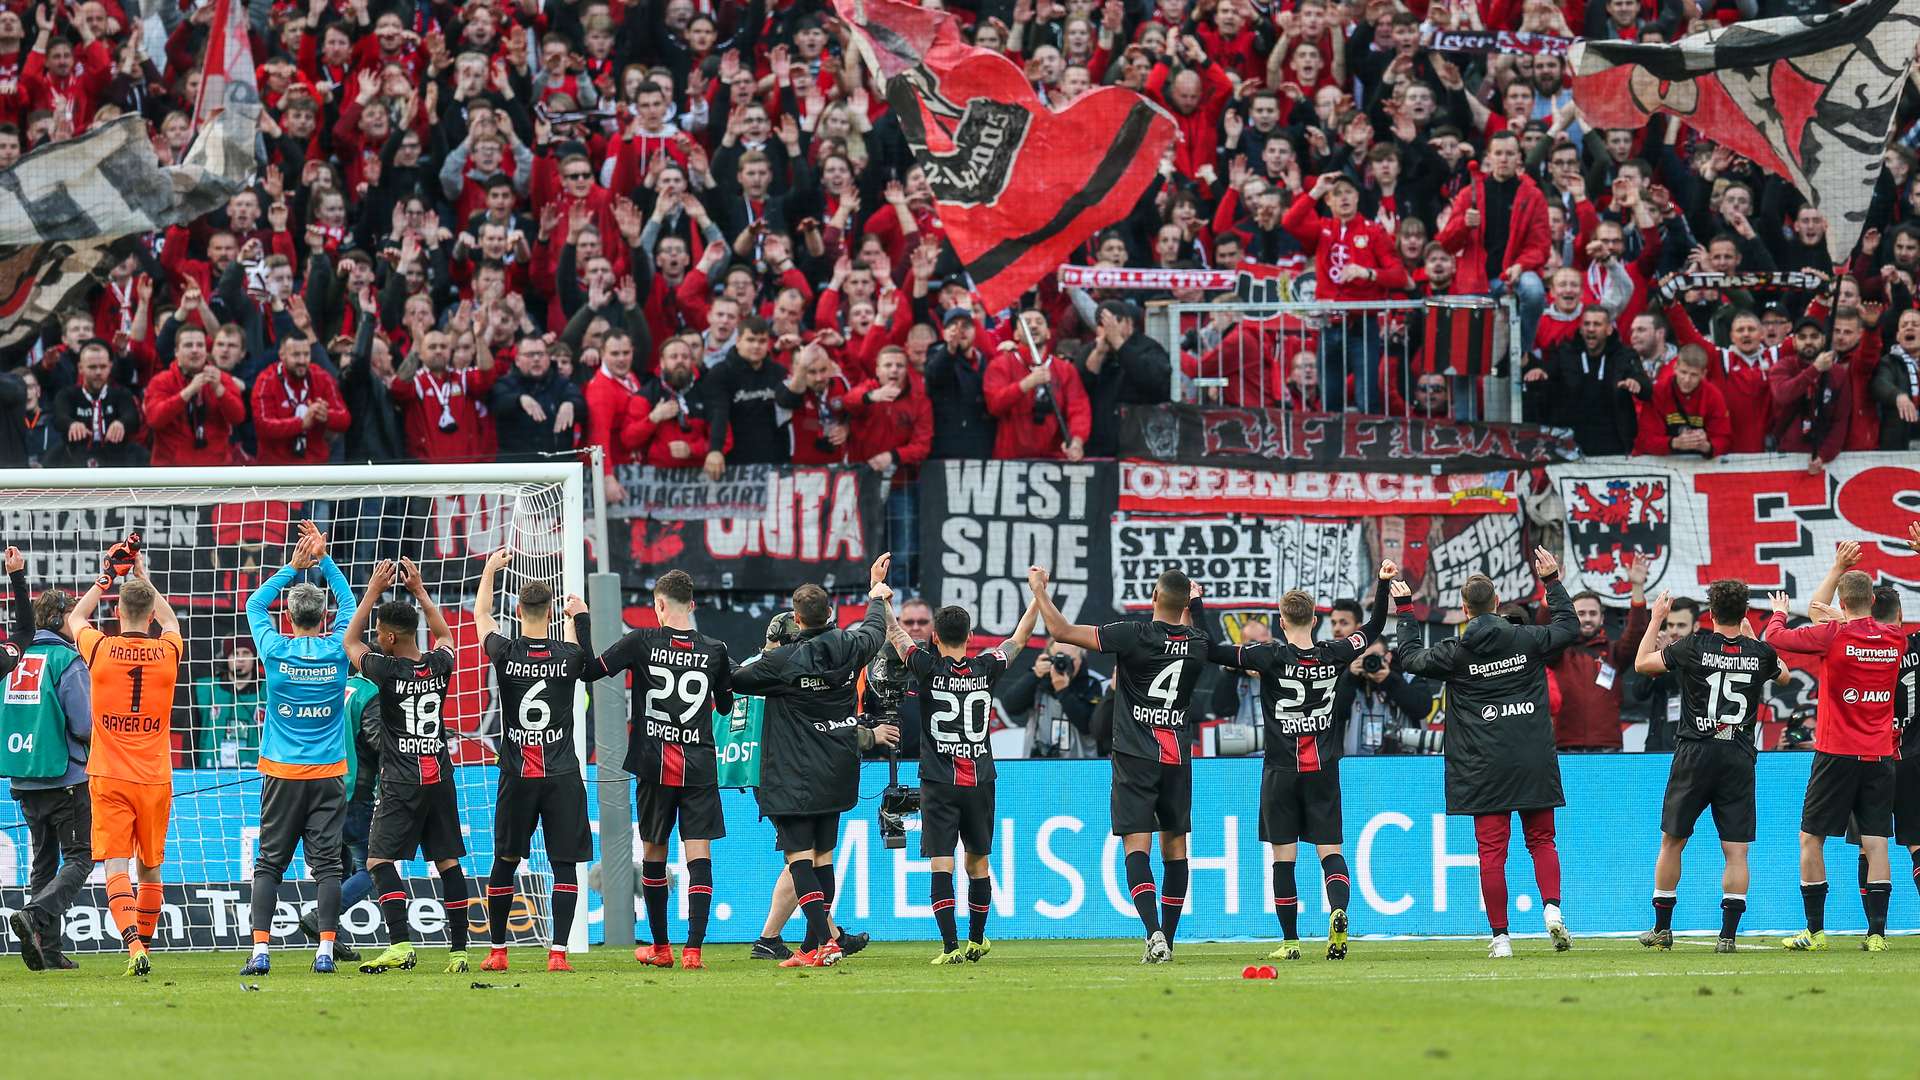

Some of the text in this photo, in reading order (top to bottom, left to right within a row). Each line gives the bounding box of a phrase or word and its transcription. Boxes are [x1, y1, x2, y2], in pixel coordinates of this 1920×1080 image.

[944, 459, 1095, 520] WEST
[1130, 461, 1437, 502] OFFENBACH
[941, 516, 1088, 581] SIDE
[1119, 524, 1272, 556] STADT
[1488, 531, 1522, 578] DIE
[1121, 580, 1270, 600] AUEBEN
[109, 645, 166, 661] HRADECKY
[650, 647, 709, 669] HAVERTZ
[1164, 641, 1188, 656] TAH
[1845, 645, 1899, 658] Barmenia
[278, 661, 338, 677] Barmenia
[505, 658, 568, 678] DRAGOVIĆ
[1285, 664, 1336, 679] WEISER
[1468, 653, 1527, 676] Barmenia
[1482, 664, 1525, 678] Versicherungen
[1701, 652, 1759, 671] BAUMGARTLINGER
[128, 664, 143, 713] 1
[395, 676, 447, 694] WENDELL
[932, 676, 946, 690] CH.
[1147, 659, 1184, 709] 4
[518, 678, 551, 731] 6
[645, 665, 709, 725] 29
[1275, 674, 1338, 721] 23
[1705, 671, 1752, 724] 15
[1861, 691, 1891, 702] JAKO
[296, 706, 332, 719] JAKO
[399, 692, 442, 738] 18
[930, 689, 992, 742] 20
[1133, 704, 1185, 726] BAYER 04
[1500, 701, 1535, 717] JAKO
[102, 714, 161, 732] BAYER 04
[646, 720, 700, 744] BAYER 04
[1282, 714, 1333, 735] BAYER 04
[7, 732, 34, 753] 04
[399, 737, 435, 754] BAYER
[508, 728, 563, 746] BAYER 04
[715, 741, 759, 765] HOST
